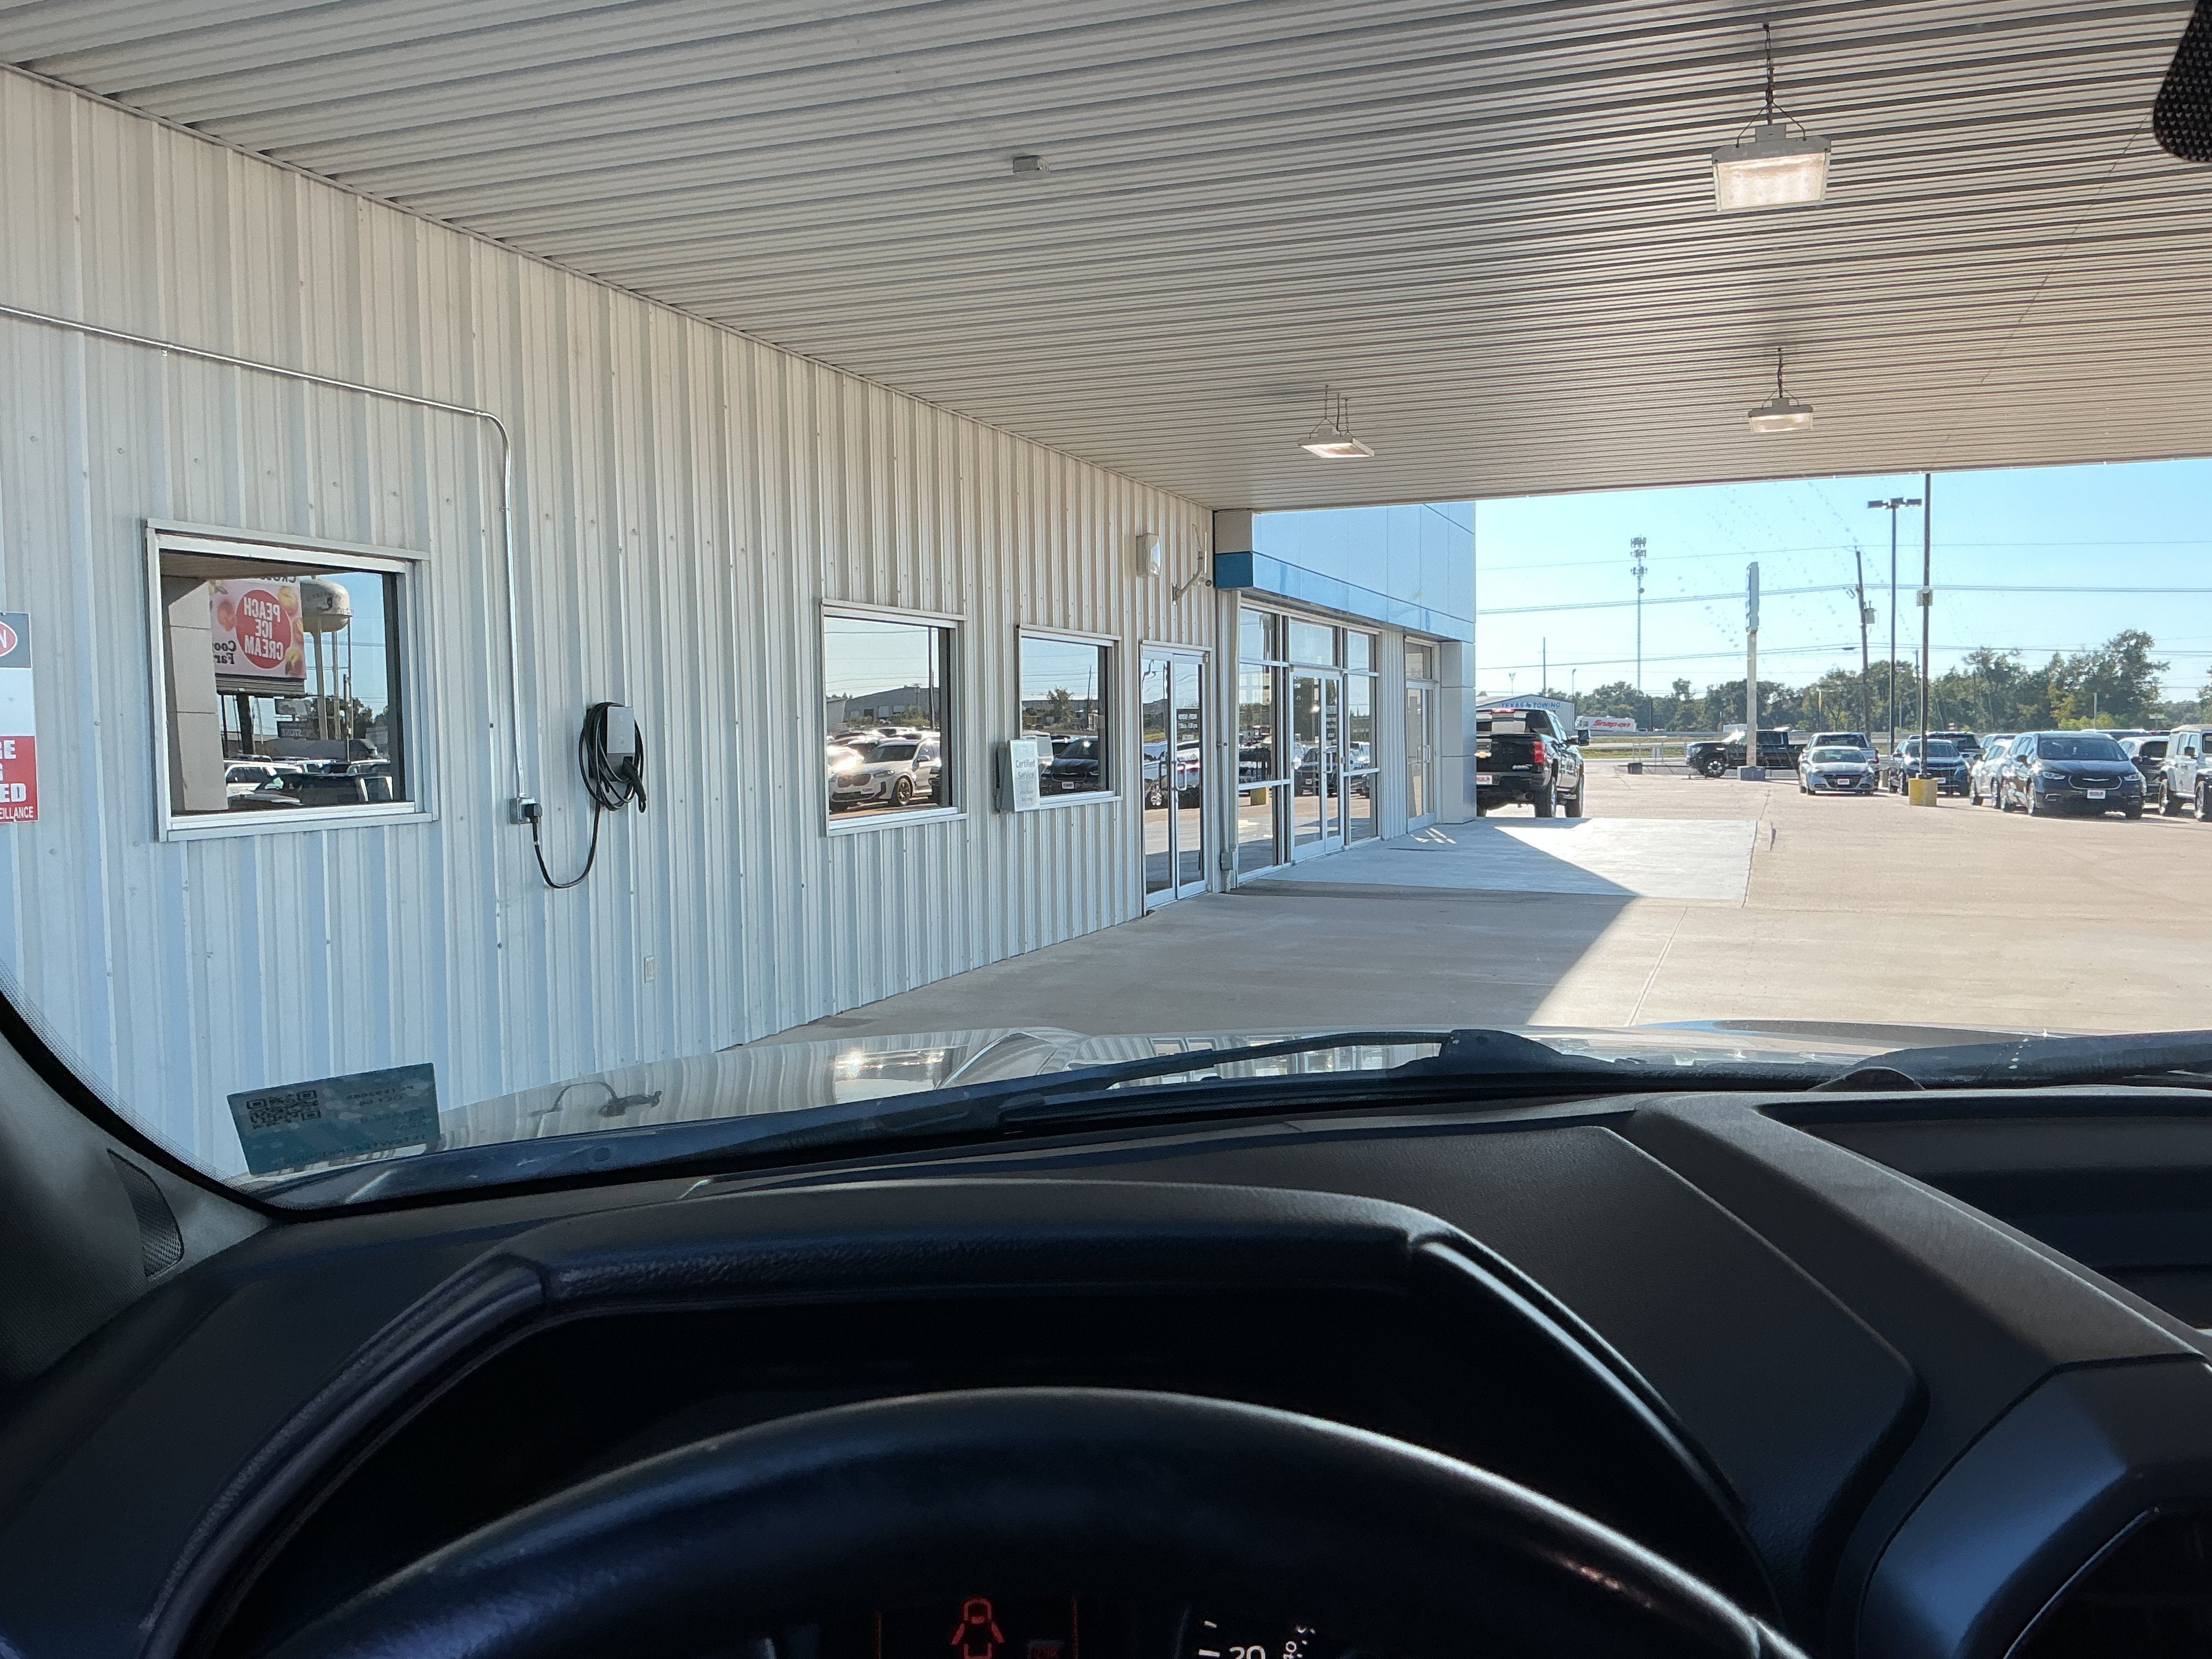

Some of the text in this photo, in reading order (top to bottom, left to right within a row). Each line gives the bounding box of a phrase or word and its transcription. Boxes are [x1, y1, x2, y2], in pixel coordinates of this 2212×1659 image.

[1593, 719, 1631, 728] Snap-on
[1015, 759, 1035, 768] Certified
[1018, 771, 1035, 780] Service
